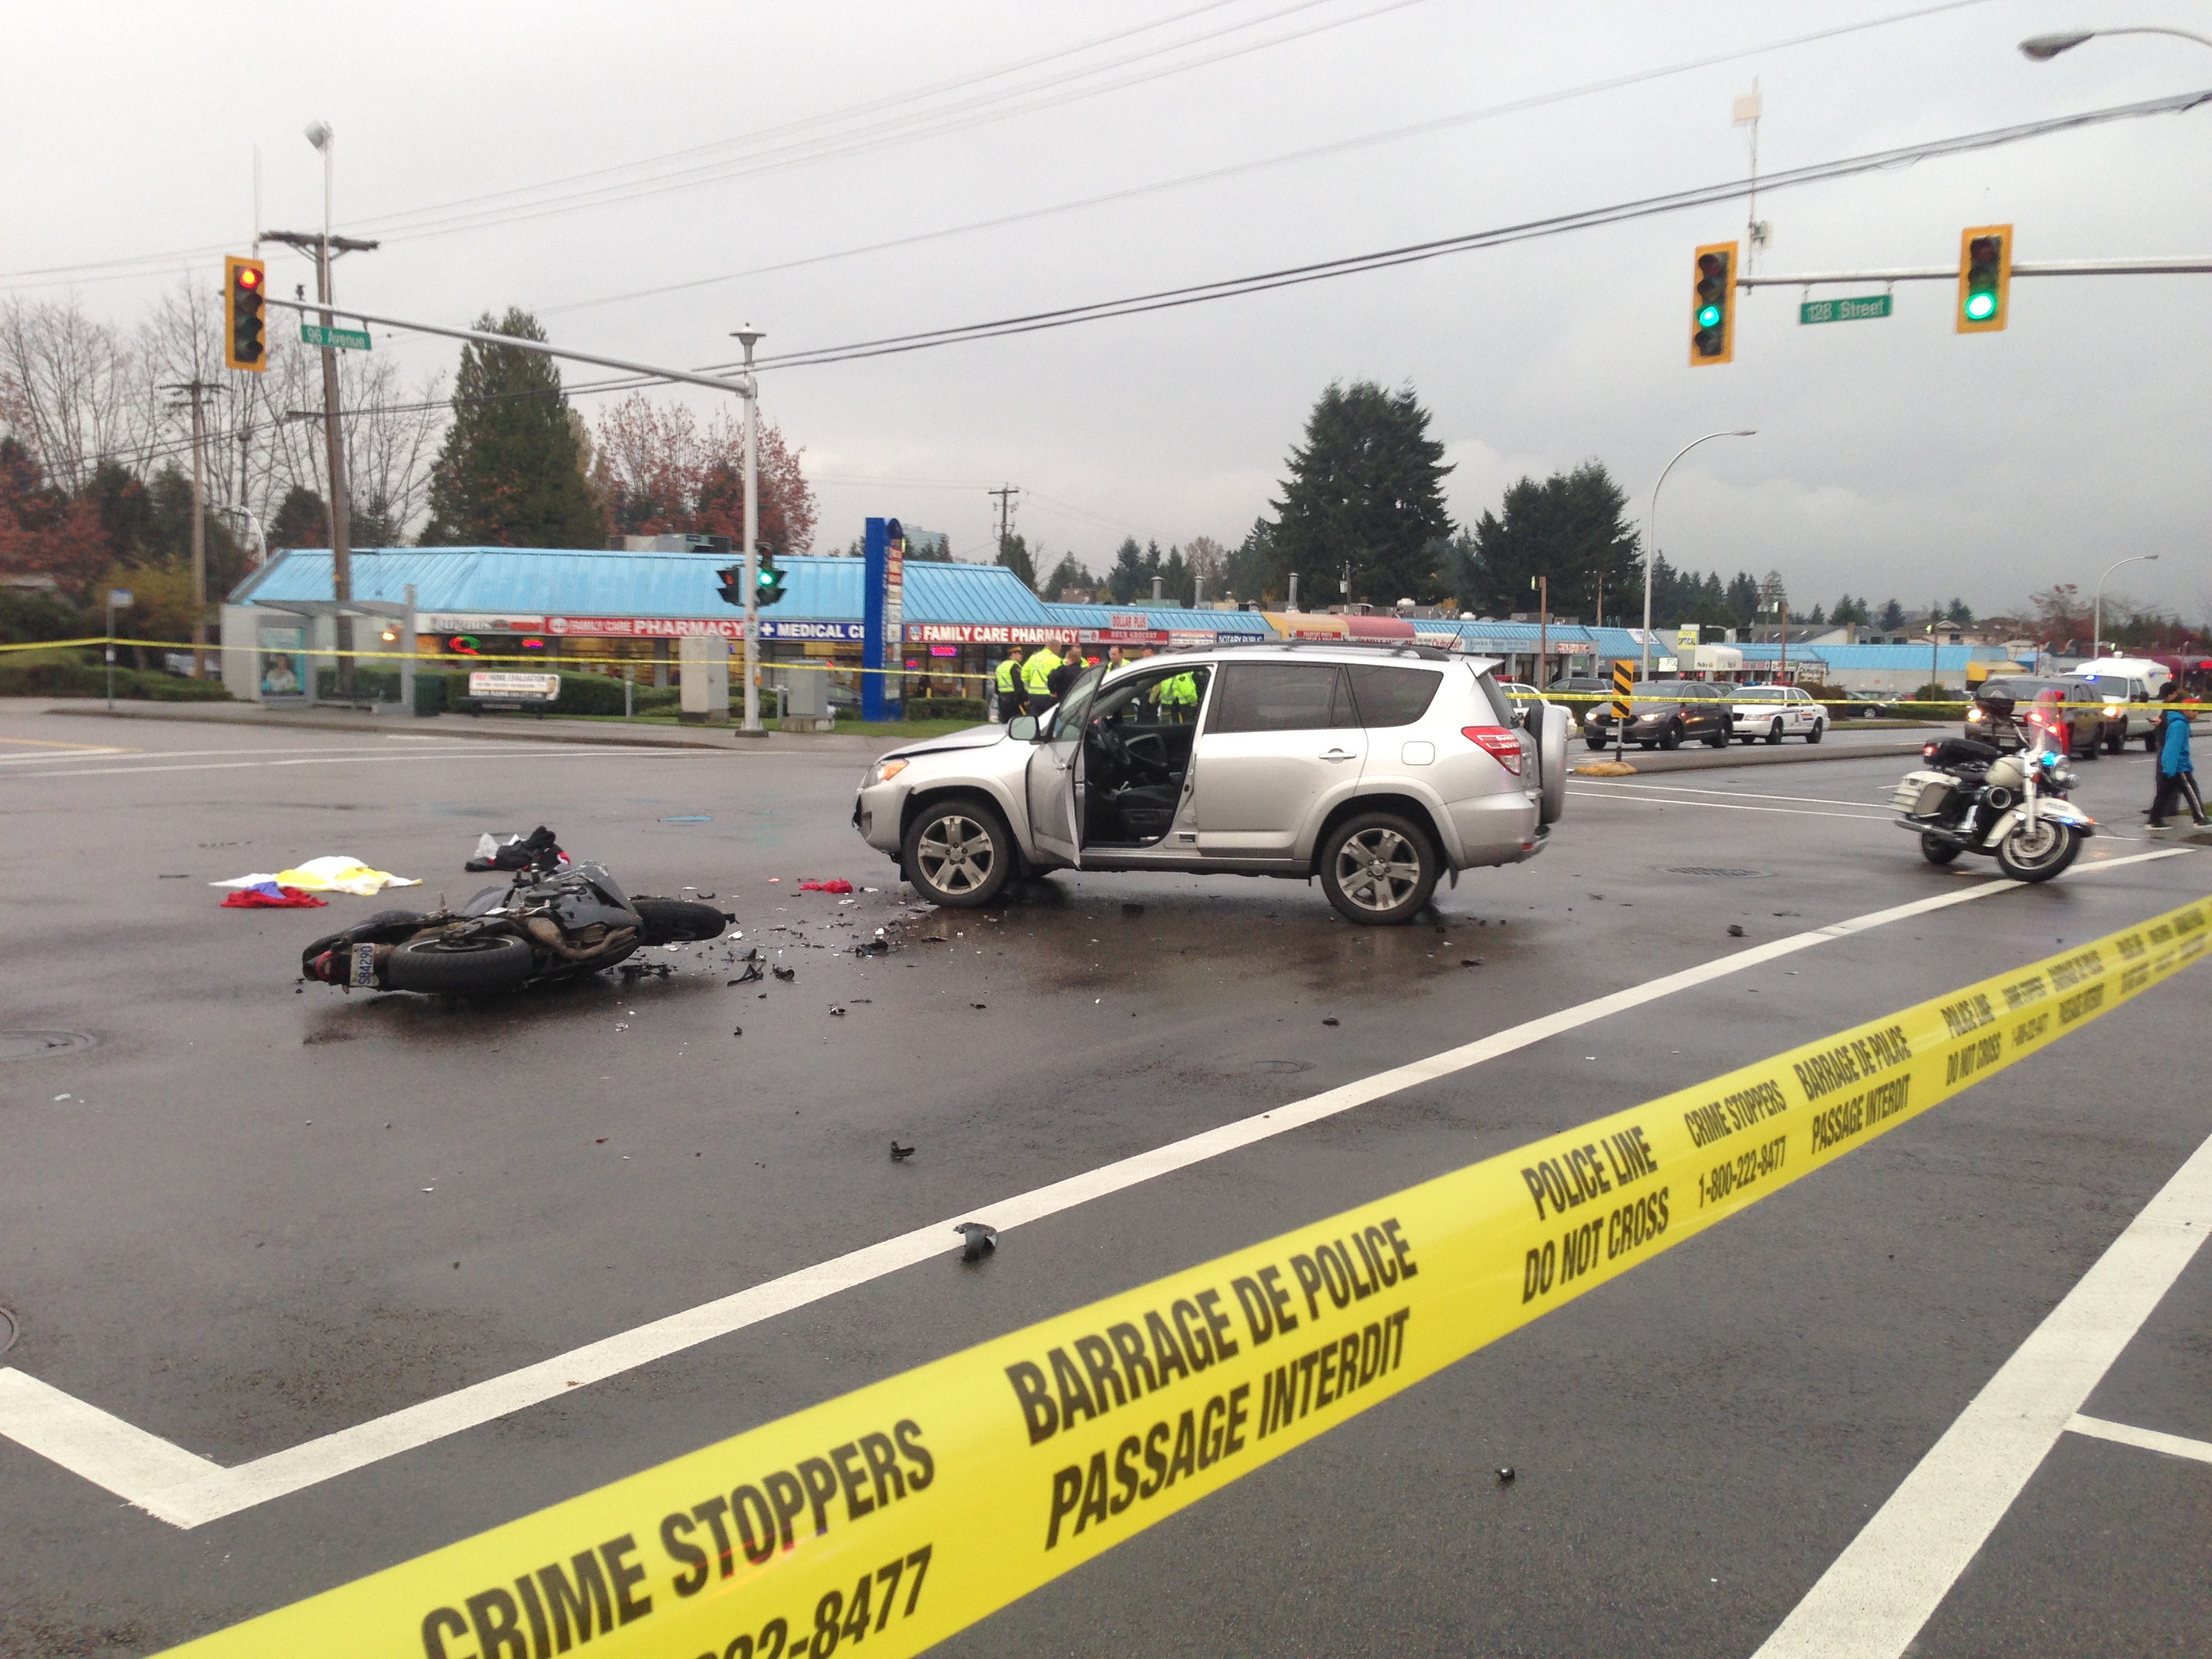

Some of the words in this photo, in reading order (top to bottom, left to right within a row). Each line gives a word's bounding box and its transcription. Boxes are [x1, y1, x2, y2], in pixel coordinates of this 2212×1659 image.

[327, 329, 365, 349] Avenue
[1807, 302, 1832, 322] 128
[1839, 299, 1884, 318] Street
[634, 619, 744, 636] PHARMACY
[777, 623, 845, 638] MEDICAL
[923, 626, 972, 641] FAMILY
[973, 628, 1009, 642] CARE
[1011, 628, 1078, 642] PHARMACY
[1113, 615, 1132, 627] DOLLAR
[1134, 617, 1147, 628] PLUS
[1218, 635, 1242, 644] NOTARY
[1793, 1046, 1860, 1102] BARRAGE
[1849, 1039, 1877, 1077] DE
[1866, 1025, 1912, 1070] POLICE
[1684, 1101, 1733, 1148] CRIME
[1723, 1078, 1787, 1131] STOPPERS
[1811, 1094, 1864, 1155] PASSAGE
[1866, 1073, 1911, 1128] INTERDIT
[1520, 1143, 1612, 1221] POLICE
[1600, 1125, 1658, 1187] LINE
[1698, 1134, 1786, 1209] 1-800-222-8477
[1521, 1240, 1555, 1305] DO
[1560, 1216, 1604, 1286] NOT
[1607, 1185, 1669, 1261] CROSS
[1004, 1288, 1240, 1446] BARRAGE
[1231, 1265, 1300, 1348] DE
[1290, 1218, 1419, 1322] POLICE
[1044, 1382, 1251, 1552] PASSAGE
[1256, 1306, 1410, 1441] INTERDIT
[420, 1534, 653, 1659] CRIME
[659, 1418, 935, 1599] STOPPERS
